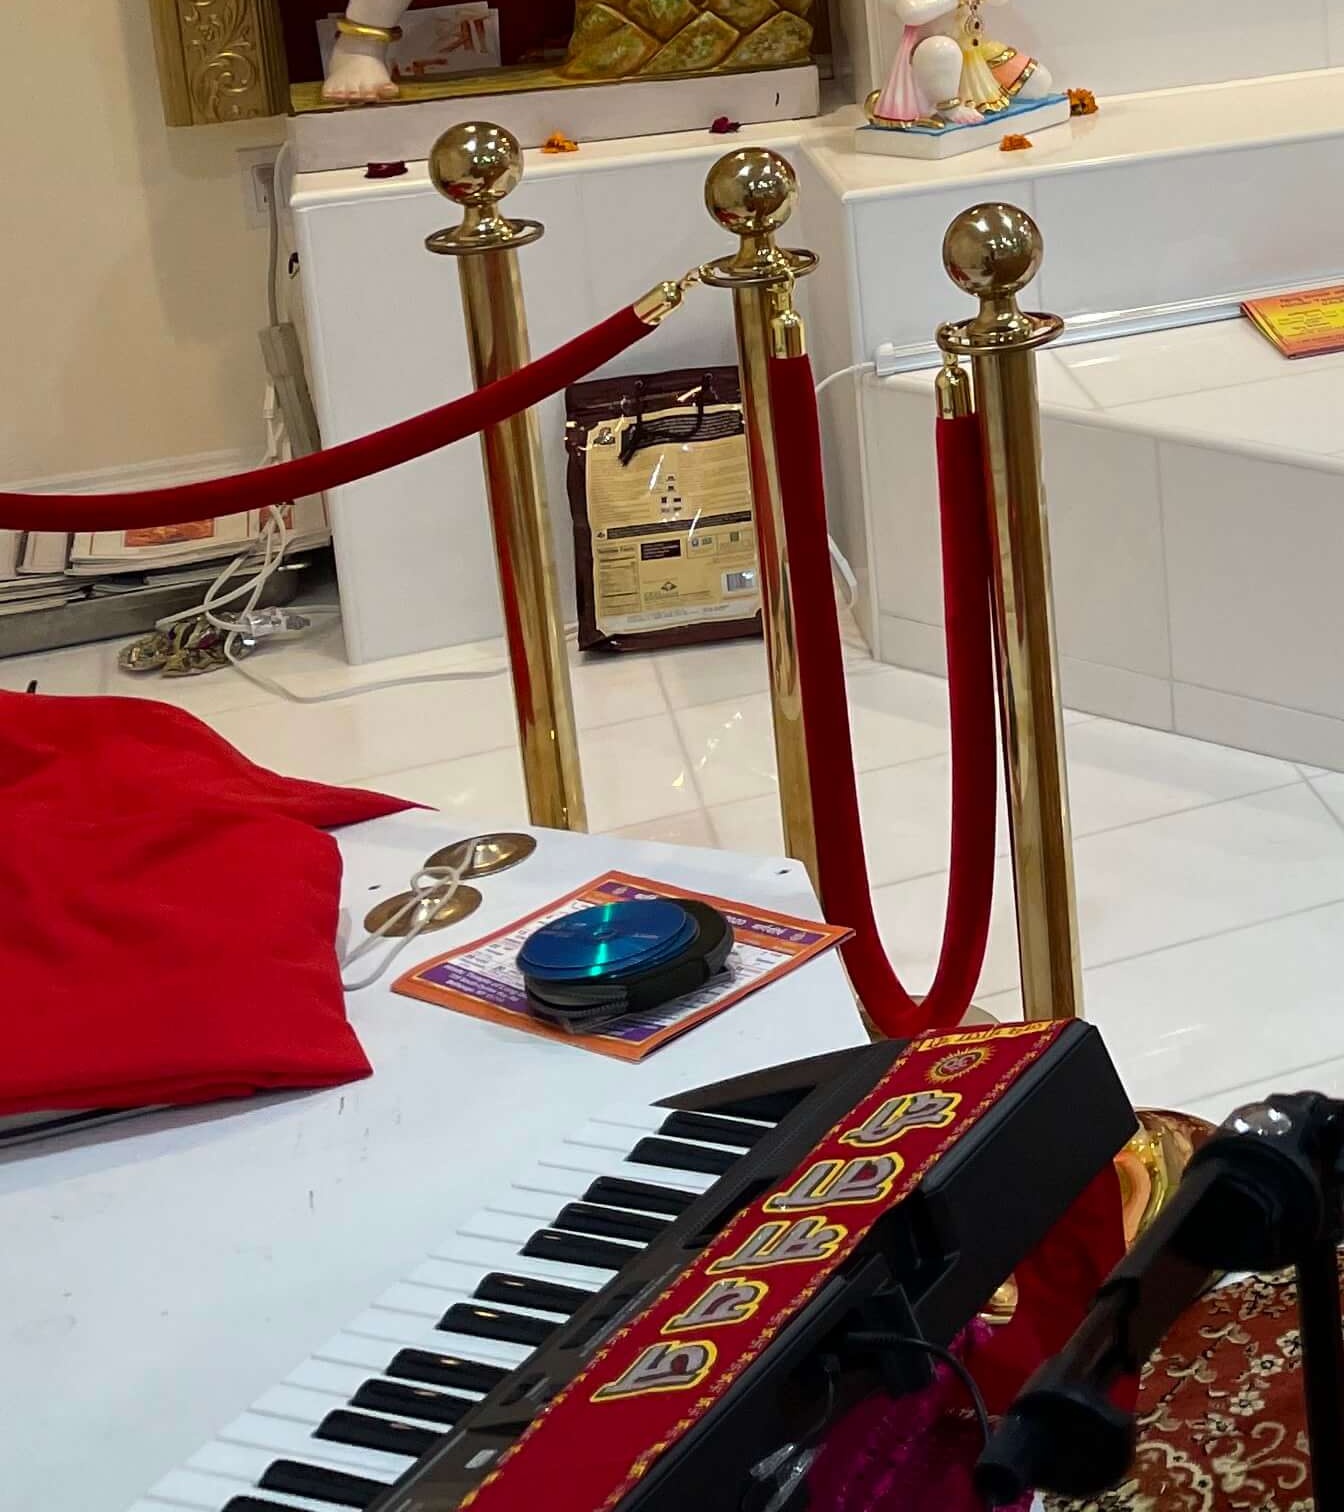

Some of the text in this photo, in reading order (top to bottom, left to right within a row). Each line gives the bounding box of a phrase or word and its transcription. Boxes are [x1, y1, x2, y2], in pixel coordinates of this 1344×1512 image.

[590, 1090, 962, 1402] जय माता दी
